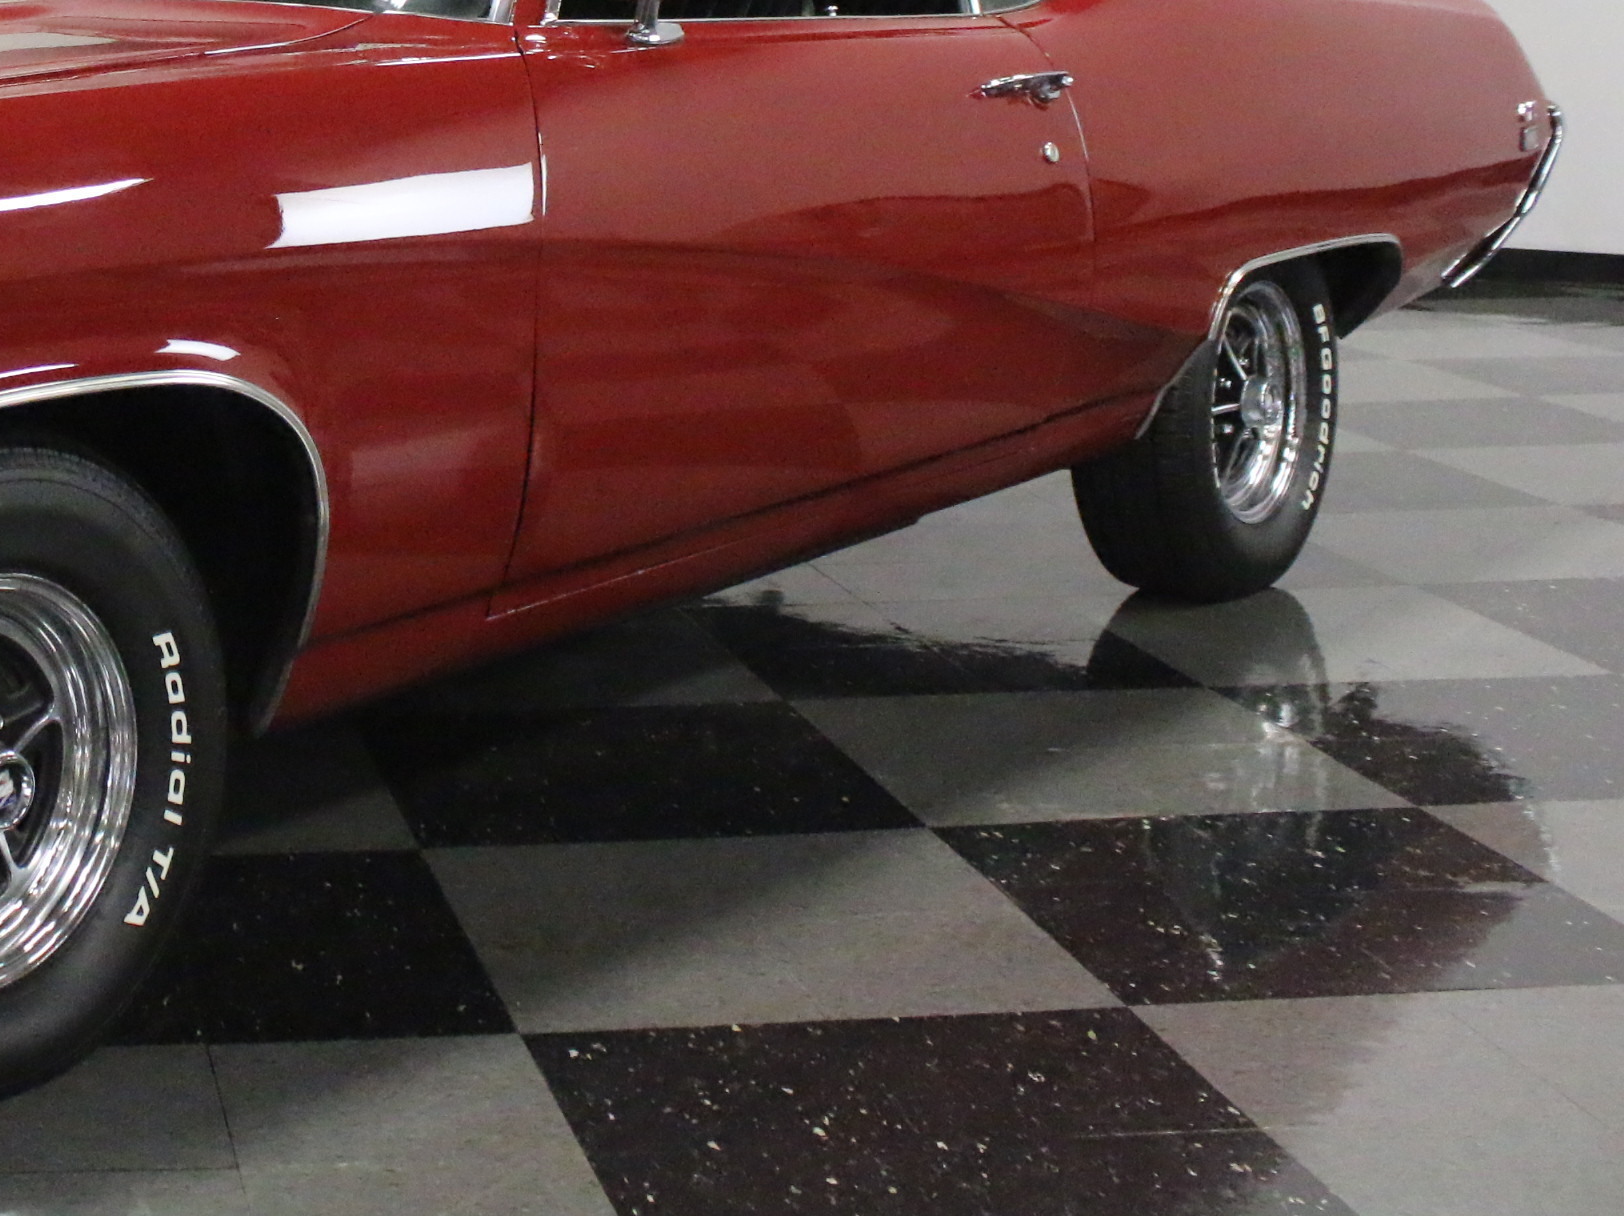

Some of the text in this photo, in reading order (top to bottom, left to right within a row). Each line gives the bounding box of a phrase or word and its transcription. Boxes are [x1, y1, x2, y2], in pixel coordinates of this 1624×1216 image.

[1302, 303, 1333, 510] BFGoodrich
[123, 632, 192, 927] Radial T/A
